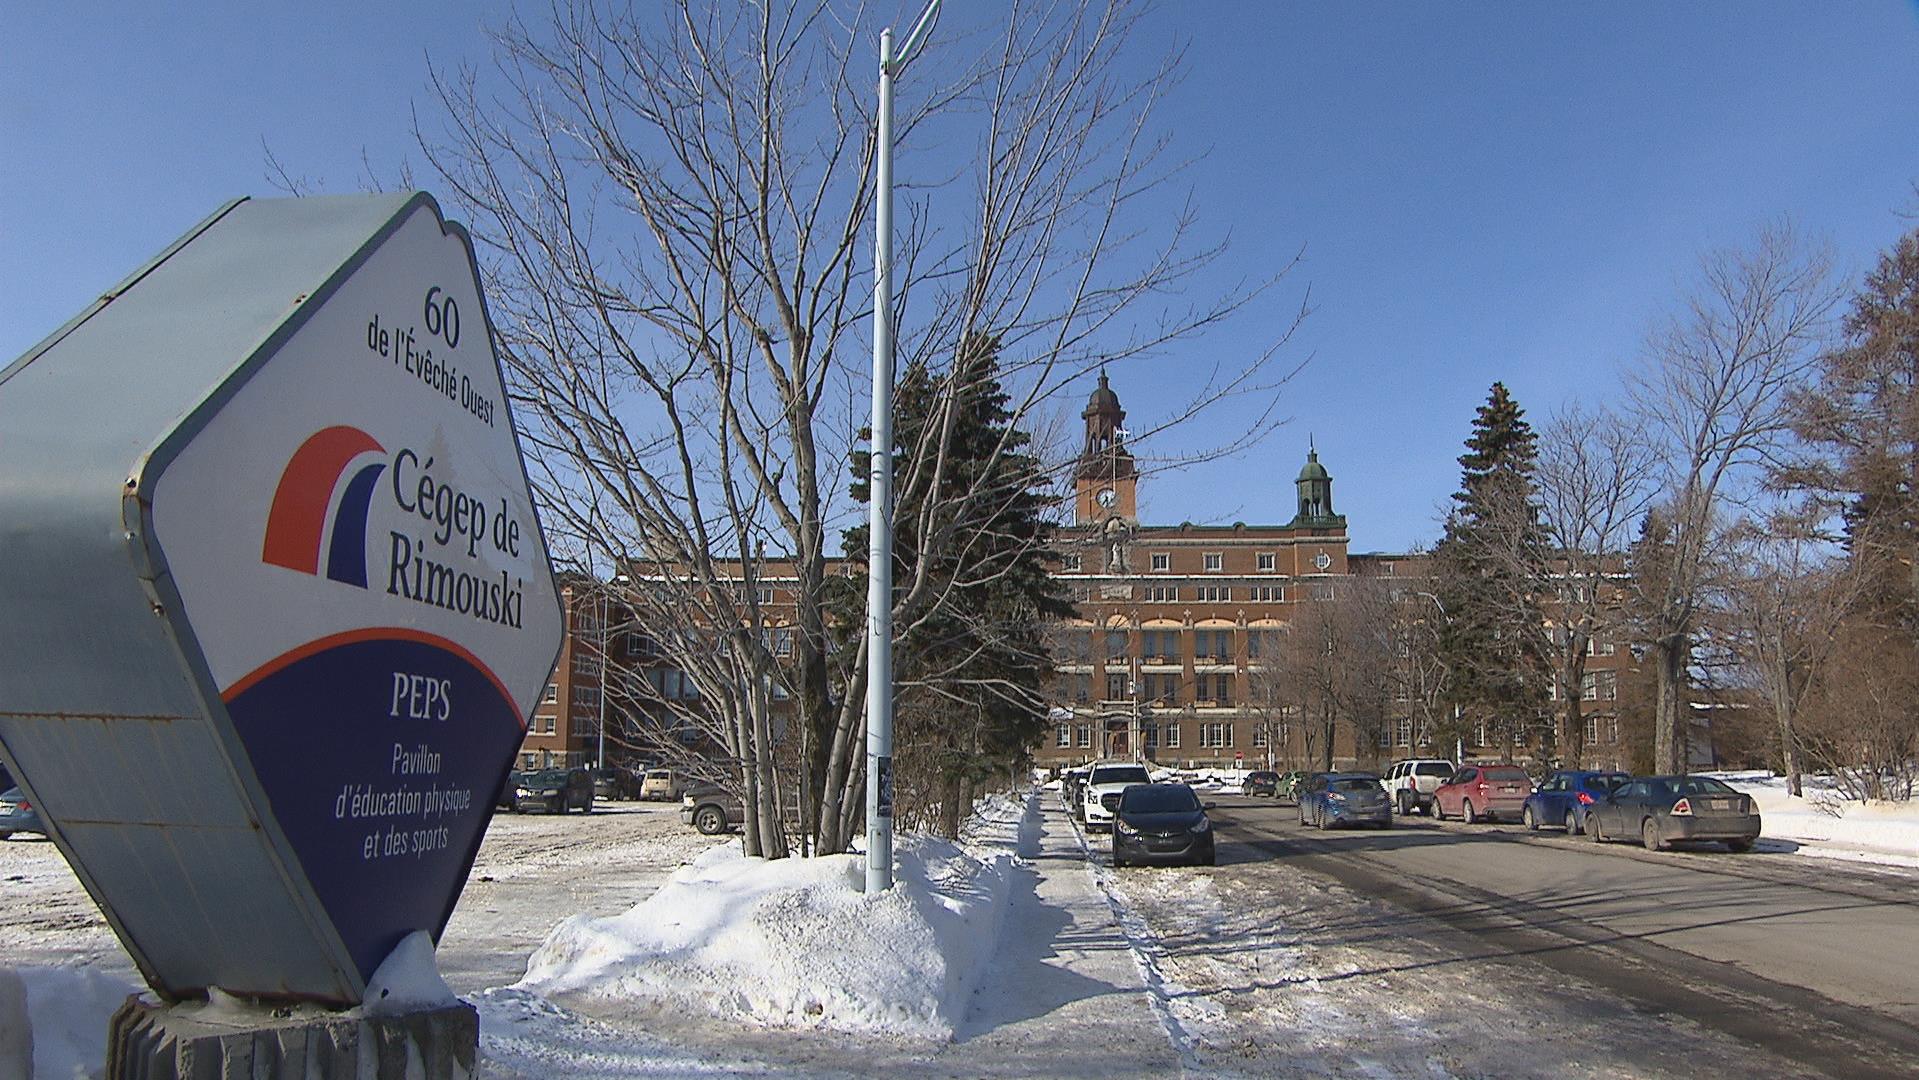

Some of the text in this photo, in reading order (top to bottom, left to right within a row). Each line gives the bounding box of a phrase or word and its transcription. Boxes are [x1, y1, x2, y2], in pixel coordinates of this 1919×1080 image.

[425, 286, 460, 348] 60
[368, 314, 494, 428] de l'Évêché Ouest
[393, 449, 519, 558] Cégep de
[387, 531, 522, 629] Rimouski
[390, 672, 451, 721] PEPS
[392, 743, 441, 774] Pavillon
[335, 782, 471, 820] d'éducation physique
[364, 825, 449, 859] et des sports
